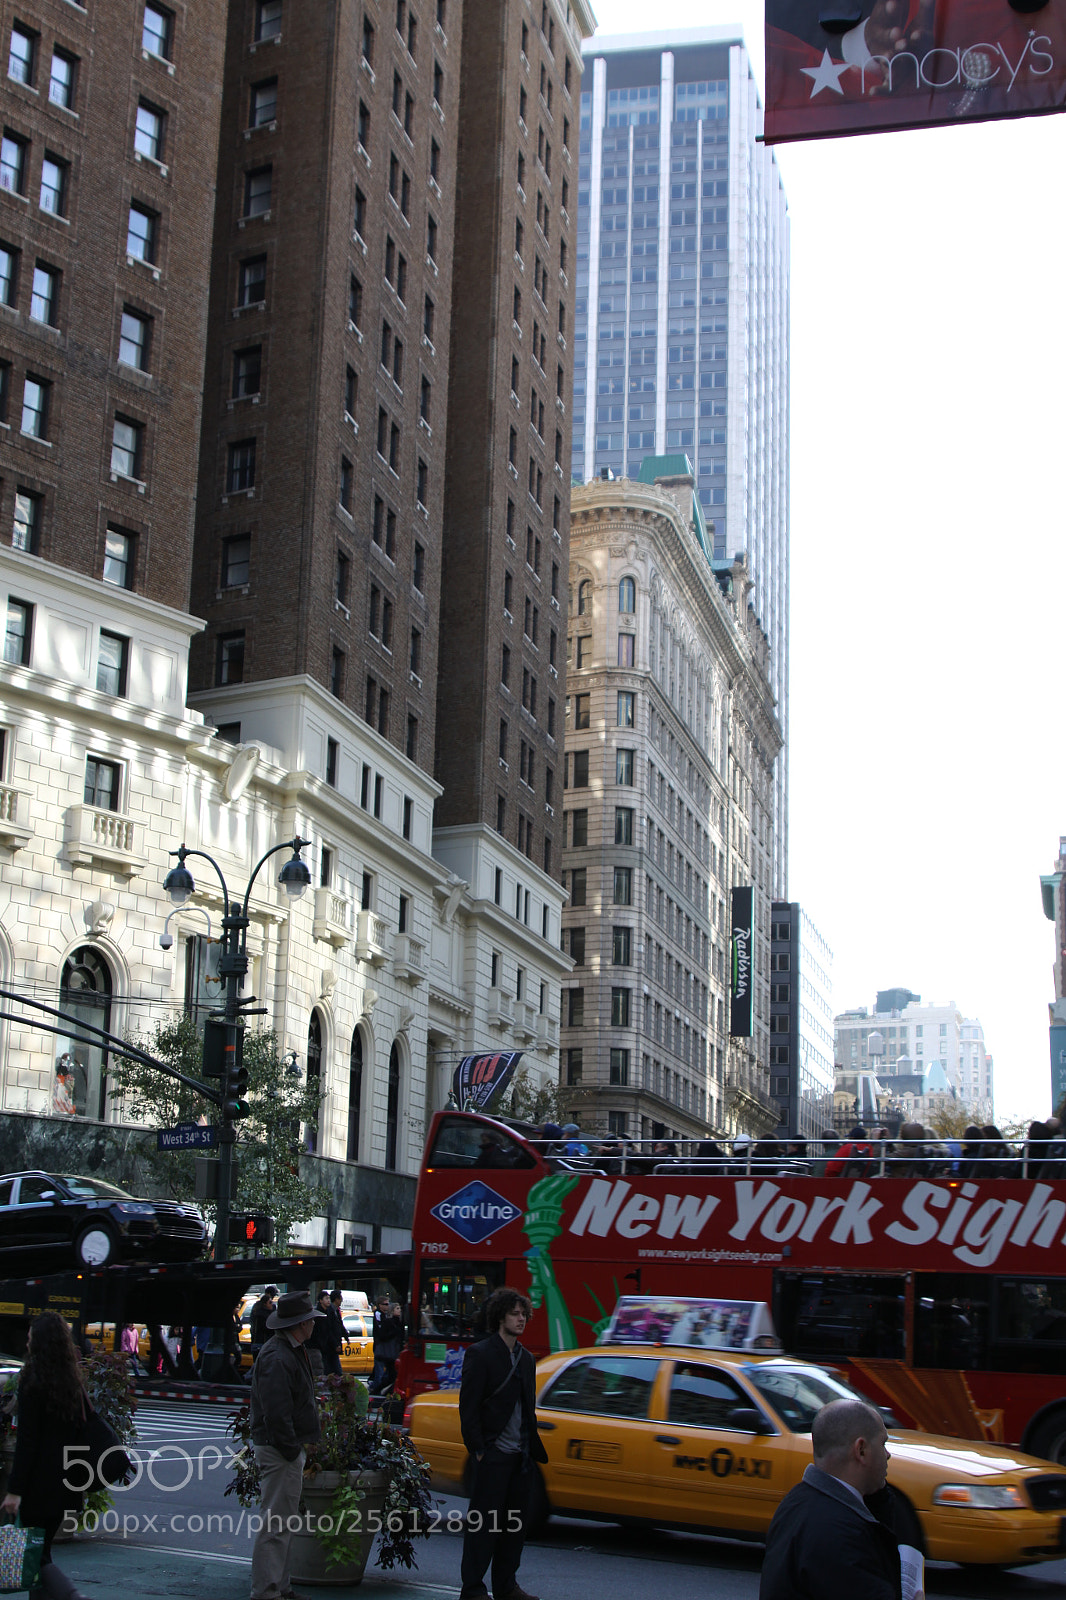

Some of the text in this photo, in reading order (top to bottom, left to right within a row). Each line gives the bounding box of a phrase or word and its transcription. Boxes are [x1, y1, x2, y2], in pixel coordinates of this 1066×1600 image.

[733, 926, 751, 999] Radisson
[162, 1130, 211, 1145] West 34th St
[568, 1178, 1066, 1268] New York Sigh
[420, 1242, 449, 1254] 71612
[637, 1248, 783, 1264] www.newyorksightseeing.com
[344, 1345, 362, 1357] TAXI
